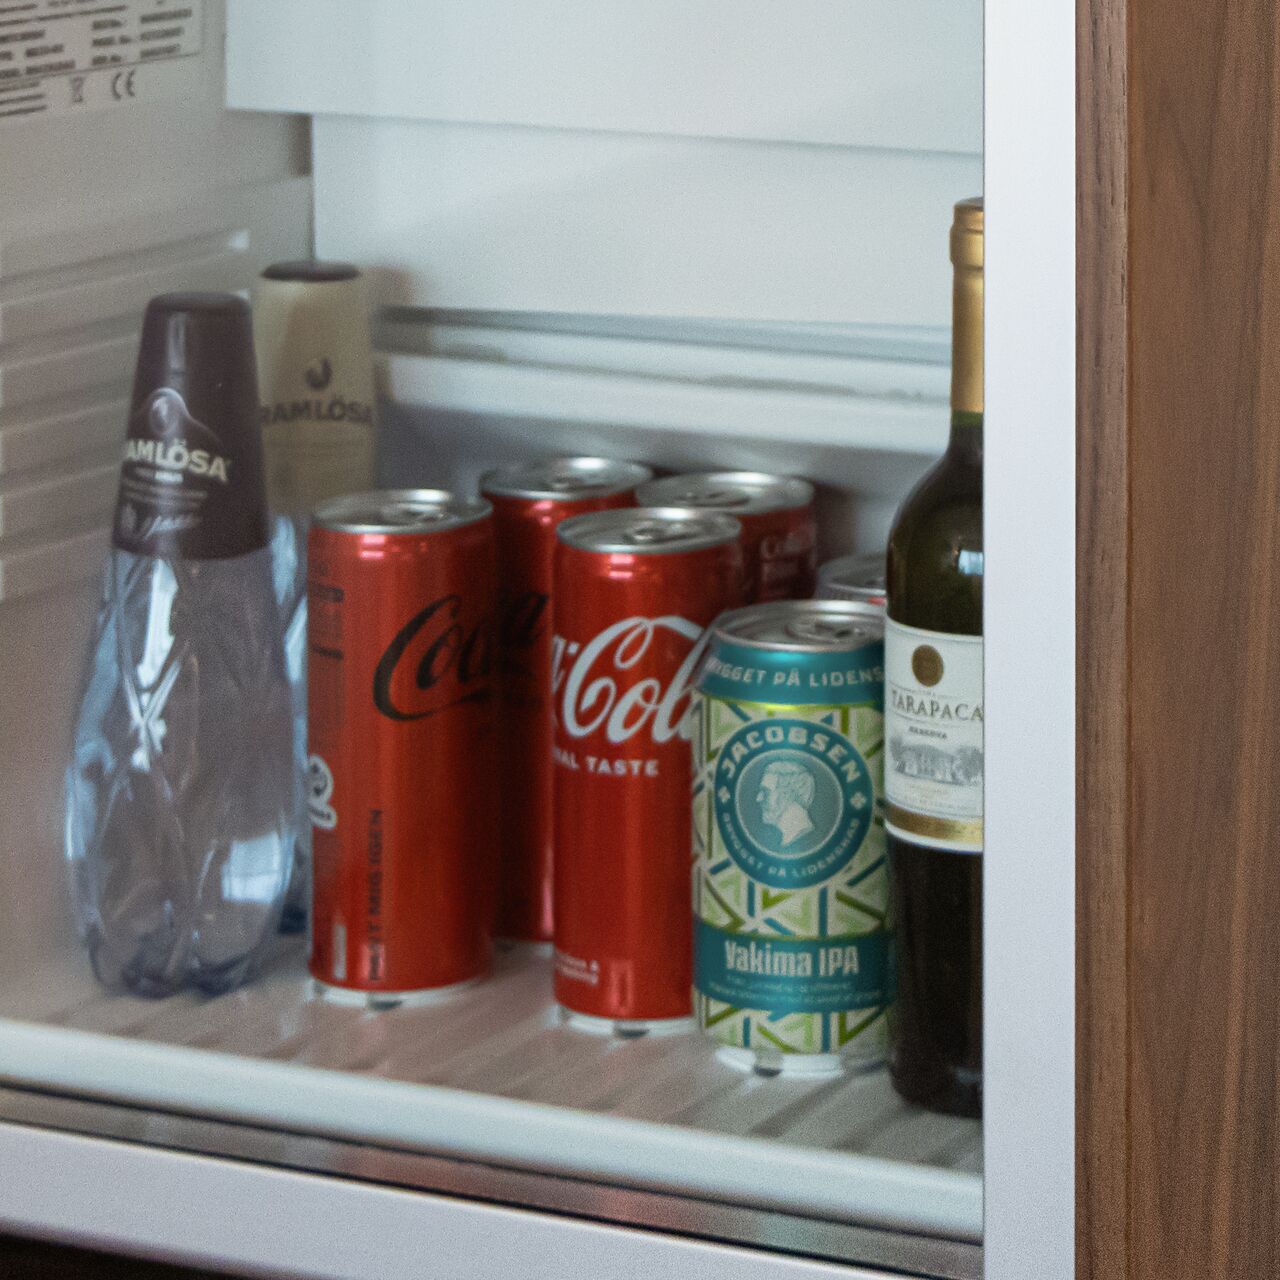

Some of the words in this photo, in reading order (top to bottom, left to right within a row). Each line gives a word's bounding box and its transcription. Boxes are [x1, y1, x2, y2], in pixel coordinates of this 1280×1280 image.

[124, 436, 229, 484] AMLÖSA
[773, 669, 800, 687] PÅ
[585, 755, 660, 778] TASTE
[721, 725, 860, 780] JACOBSEN
[725, 939, 814, 977] Yakima
[818, 945, 860, 977] IPA
